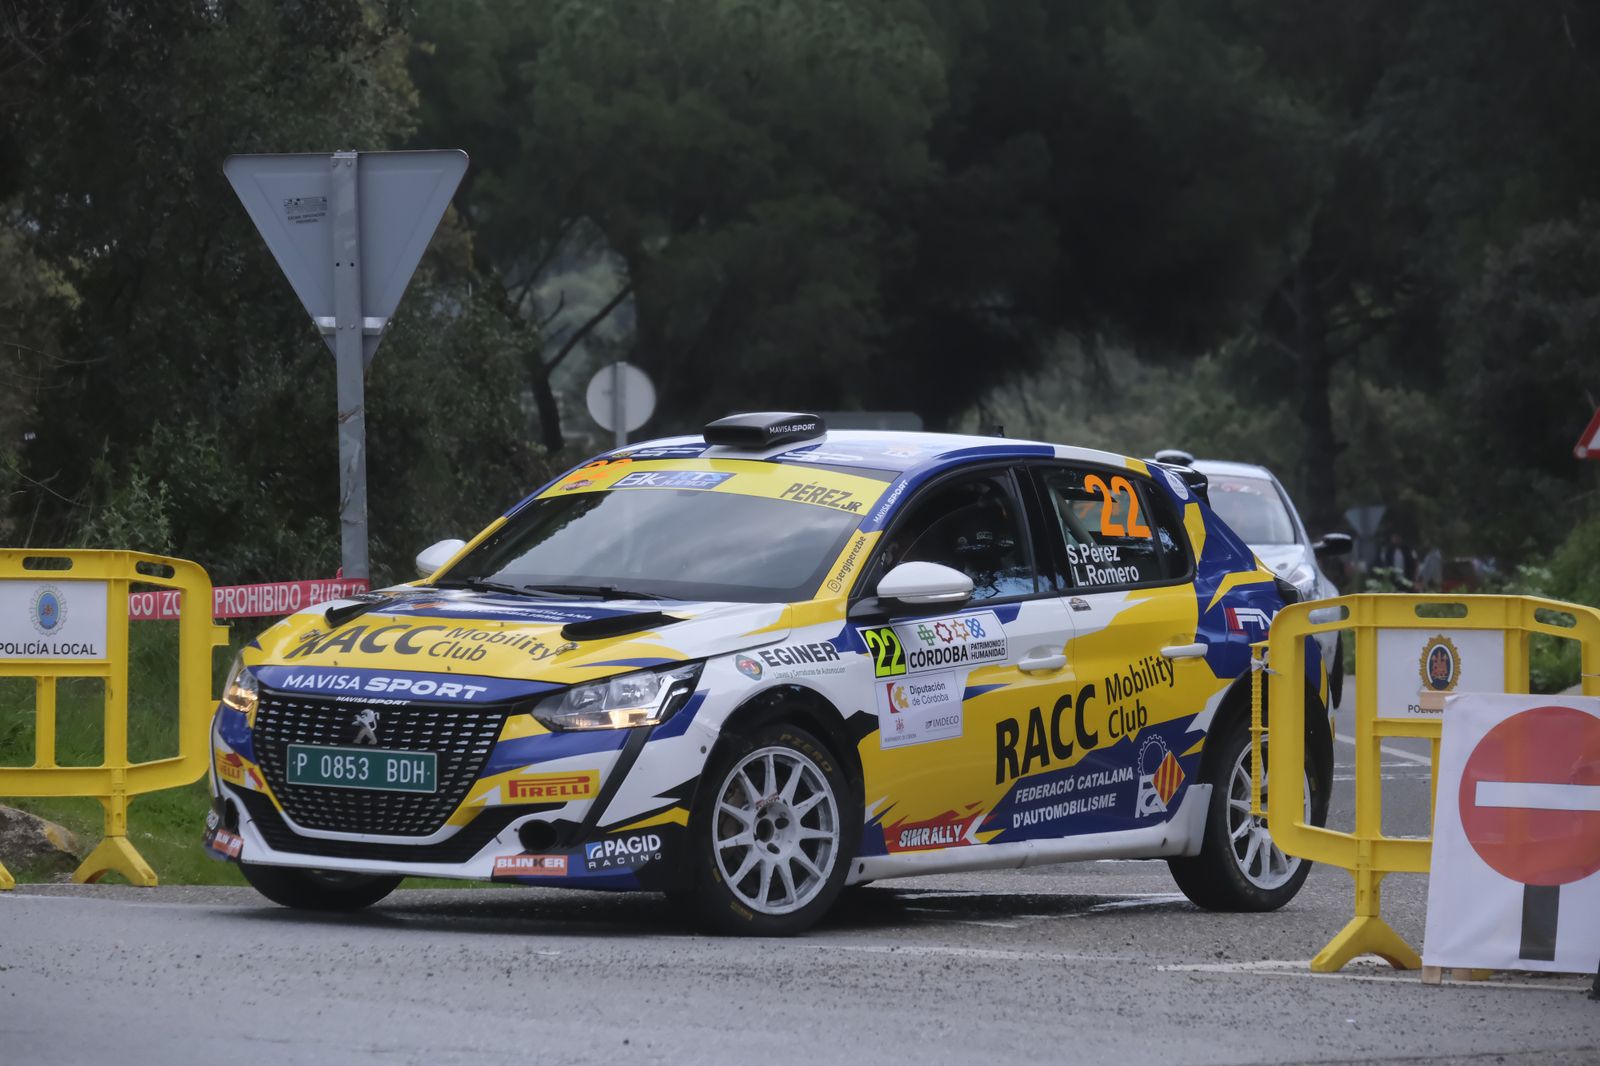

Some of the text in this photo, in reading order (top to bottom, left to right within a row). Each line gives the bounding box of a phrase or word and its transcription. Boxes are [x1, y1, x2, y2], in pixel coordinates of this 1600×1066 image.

[1084, 474, 1152, 538] 22
[1066, 543, 1120, 564] S.Pérez
[1074, 565, 1139, 586] L.Romero
[214, 584, 301, 614] PROHIBIDO
[53, 643, 97, 655] LOCAL
[428, 641, 487, 661] Club
[445, 627, 558, 661] Mobility
[758, 642, 840, 667] EGINER
[865, 628, 906, 677] 22
[910, 644, 968, 668] CÓRDOBA
[971, 648, 1005, 660] HUMANIDAD
[282, 674, 487, 700] MAVISA SPORT
[909, 681, 946, 696] Diputación
[1105, 656, 1175, 705] Mobility
[921, 693, 949, 705] Córdoba
[1108, 699, 1148, 739] Club
[996, 684, 1098, 785] RACC
[297, 753, 425, 784] P 0853 BDH
[508, 776, 590, 798] PIRELLI
[1015, 766, 1134, 804] FEDERACIÓ CATALANA
[1013, 793, 1117, 829] D'AUTOMOBILISME
[604, 834, 661, 857] PAGID
[899, 824, 963, 848] SIMRALLY
[497, 858, 564, 868] BLINKER
[588, 853, 662, 869] RACING
